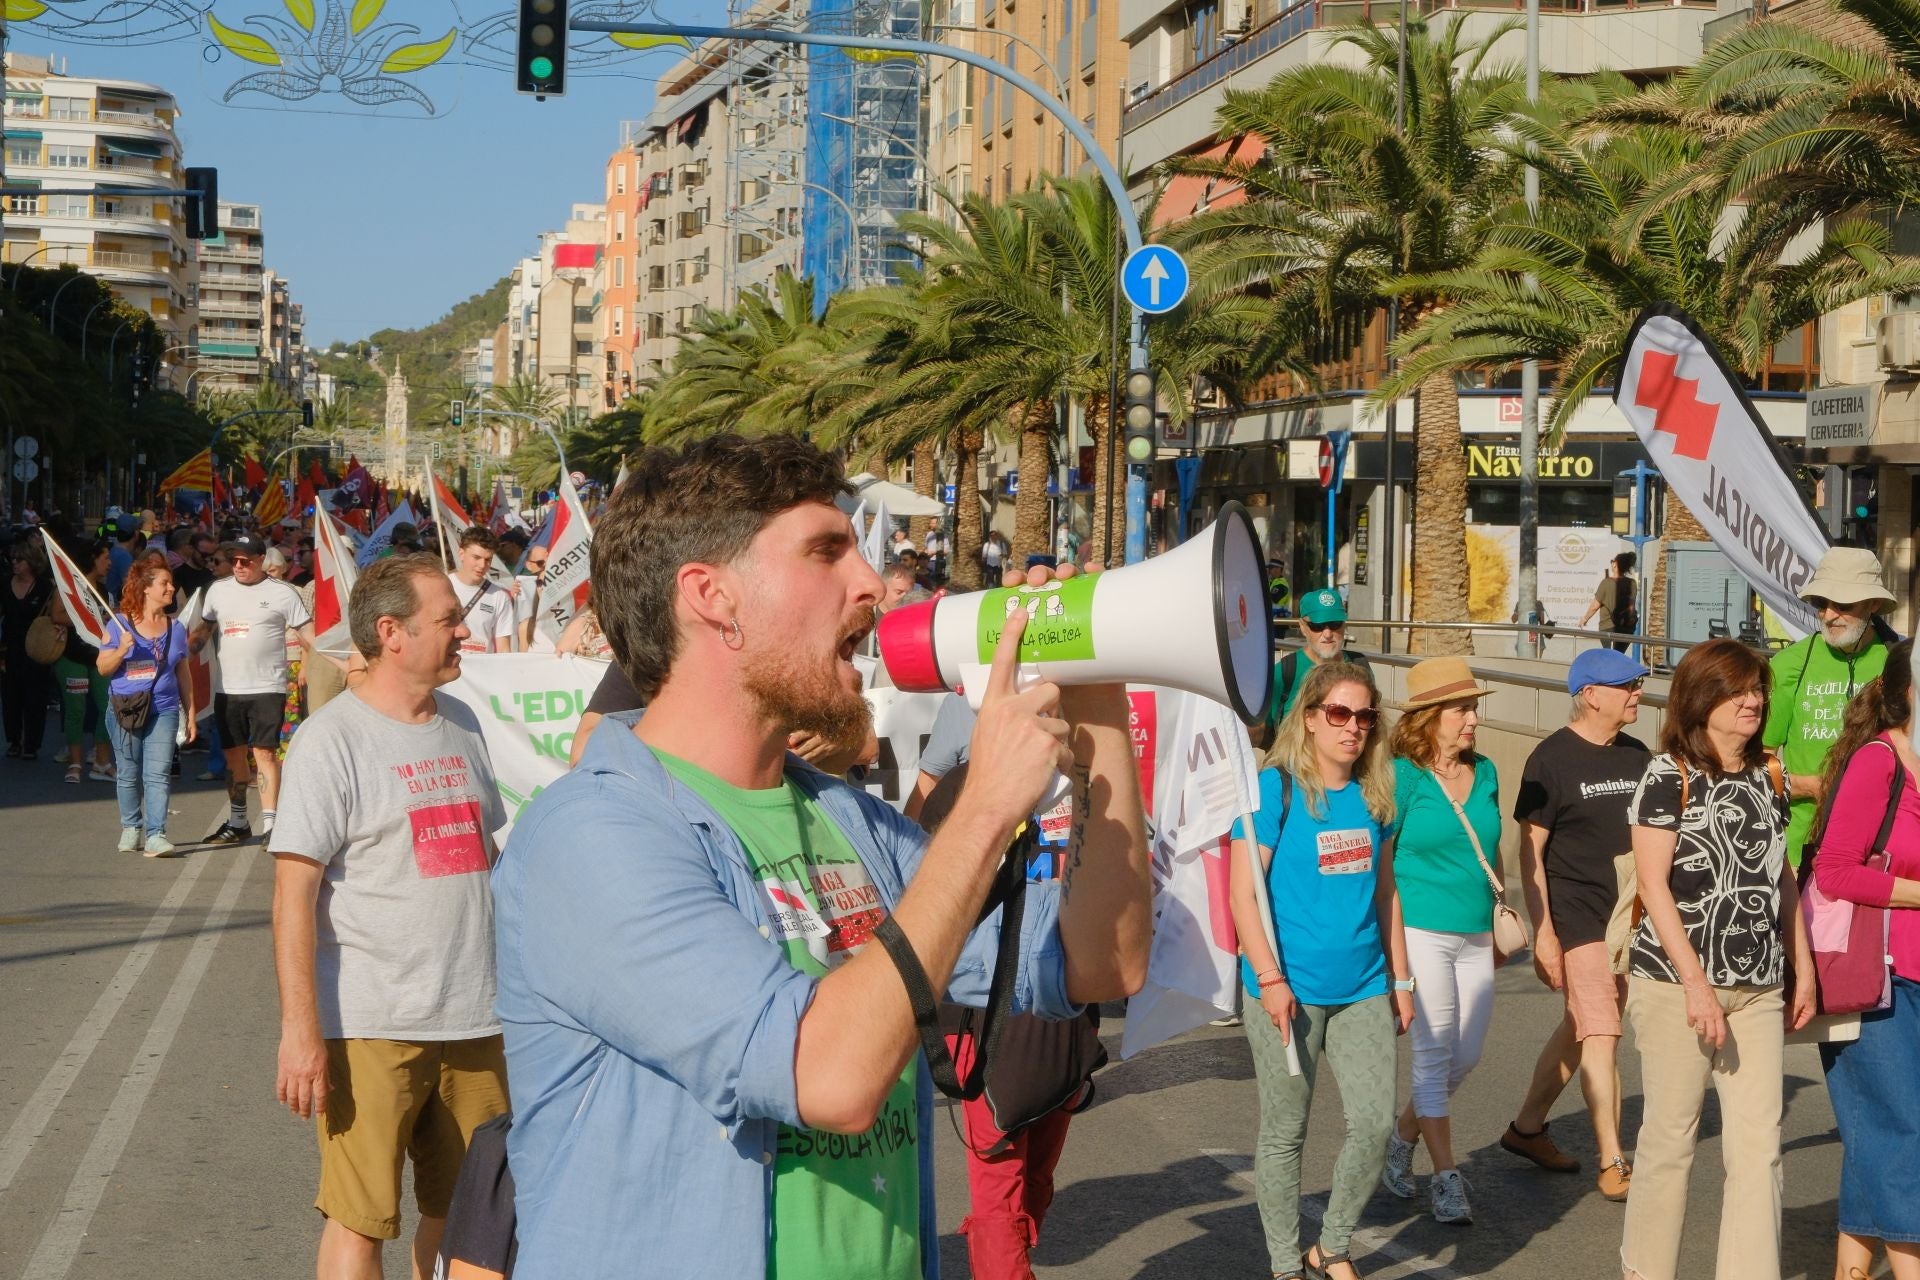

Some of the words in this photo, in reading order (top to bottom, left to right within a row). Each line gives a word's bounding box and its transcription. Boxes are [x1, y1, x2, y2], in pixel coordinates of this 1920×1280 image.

[1811, 395, 1865, 417] CAFETERIA
[1810, 422, 1864, 441] CERVECERIA
[415, 760, 438, 775] HAY
[438, 755, 467, 771] MUROS
[408, 780, 424, 794] EN
[426, 777, 438, 791] LA
[1319, 833, 1342, 844] VAGA
